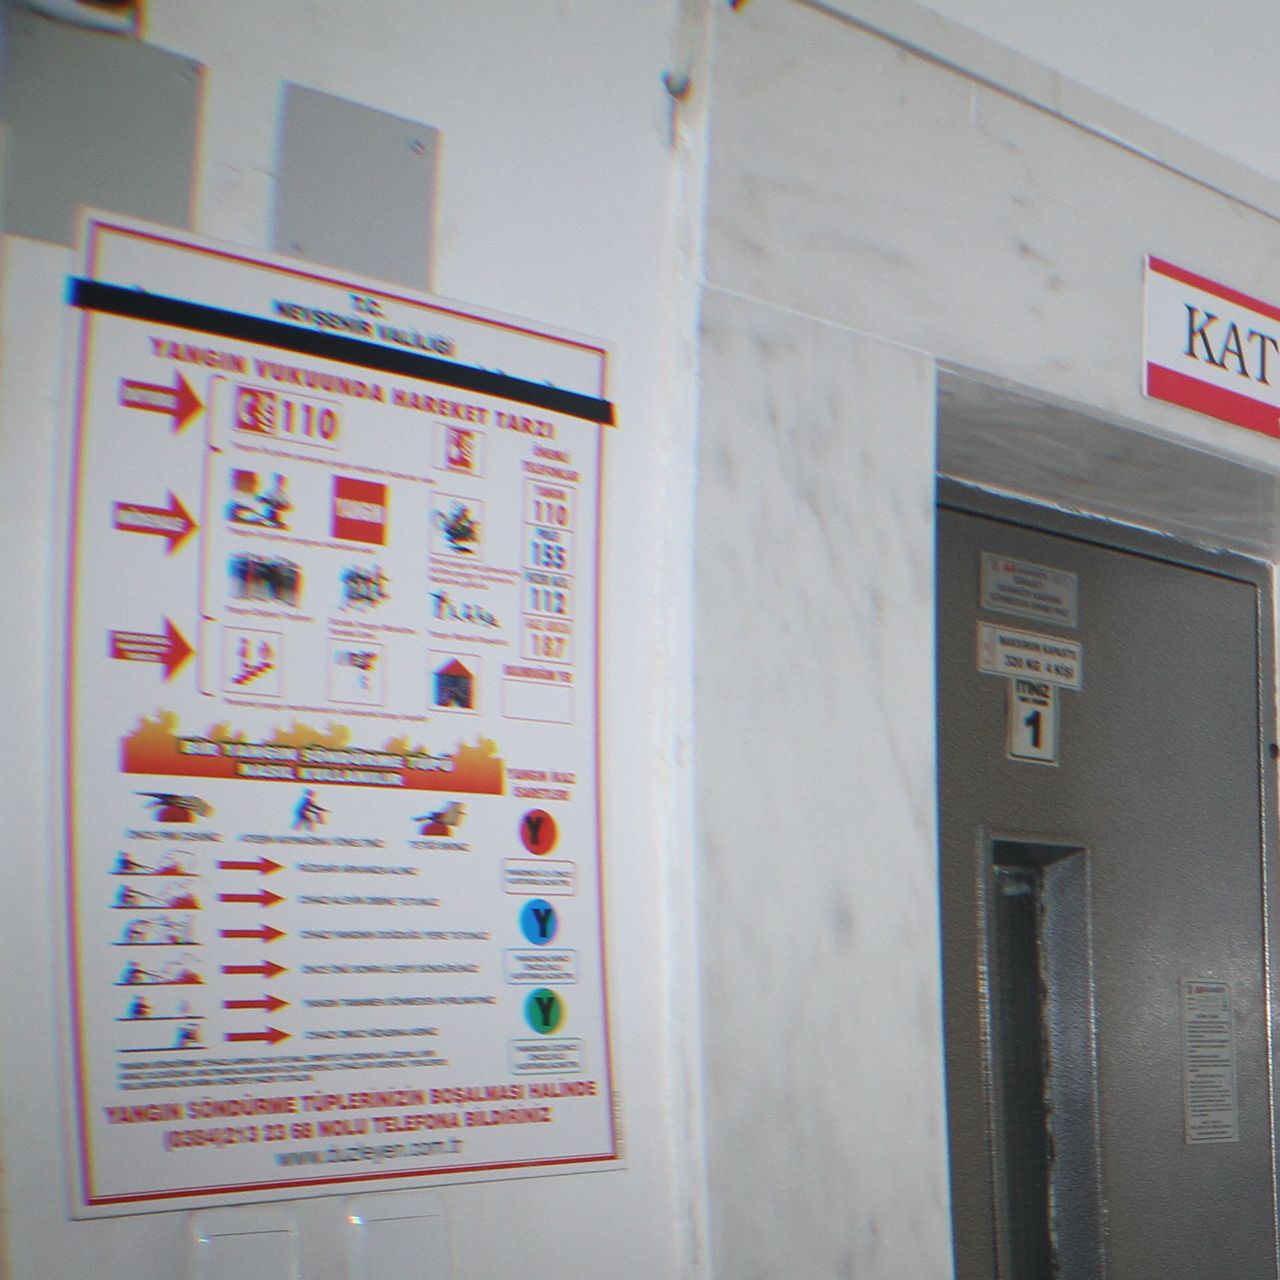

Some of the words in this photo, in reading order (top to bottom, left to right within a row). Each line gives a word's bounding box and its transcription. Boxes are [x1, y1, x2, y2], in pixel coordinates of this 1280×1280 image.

[1183, 303, 1280, 386] KAT
[149, 336, 246, 373] YANGIN
[254, 358, 385, 402] VUKUUNDA
[392, 388, 489, 423] HAREKET
[496, 411, 557, 439] TARZI
[282, 400, 340, 440] 110
[533, 499, 569, 527] 110
[531, 541, 567, 569] 155
[529, 586, 567, 615] 112
[1024, 709, 1041, 748] 1
[524, 816, 543, 845] Y
[532, 908, 552, 938] Y
[534, 996, 555, 1026] Y
[103, 1103, 185, 1124] YANGIN
[187, 1093, 298, 1120] SÖNDÜRME
[429, 1082, 525, 1105] BOŞALMASI
[528, 1078, 597, 1098] HALİNDE
[317, 1118, 369, 1137] NOLU
[373, 1112, 462, 1133] TELEFONA
